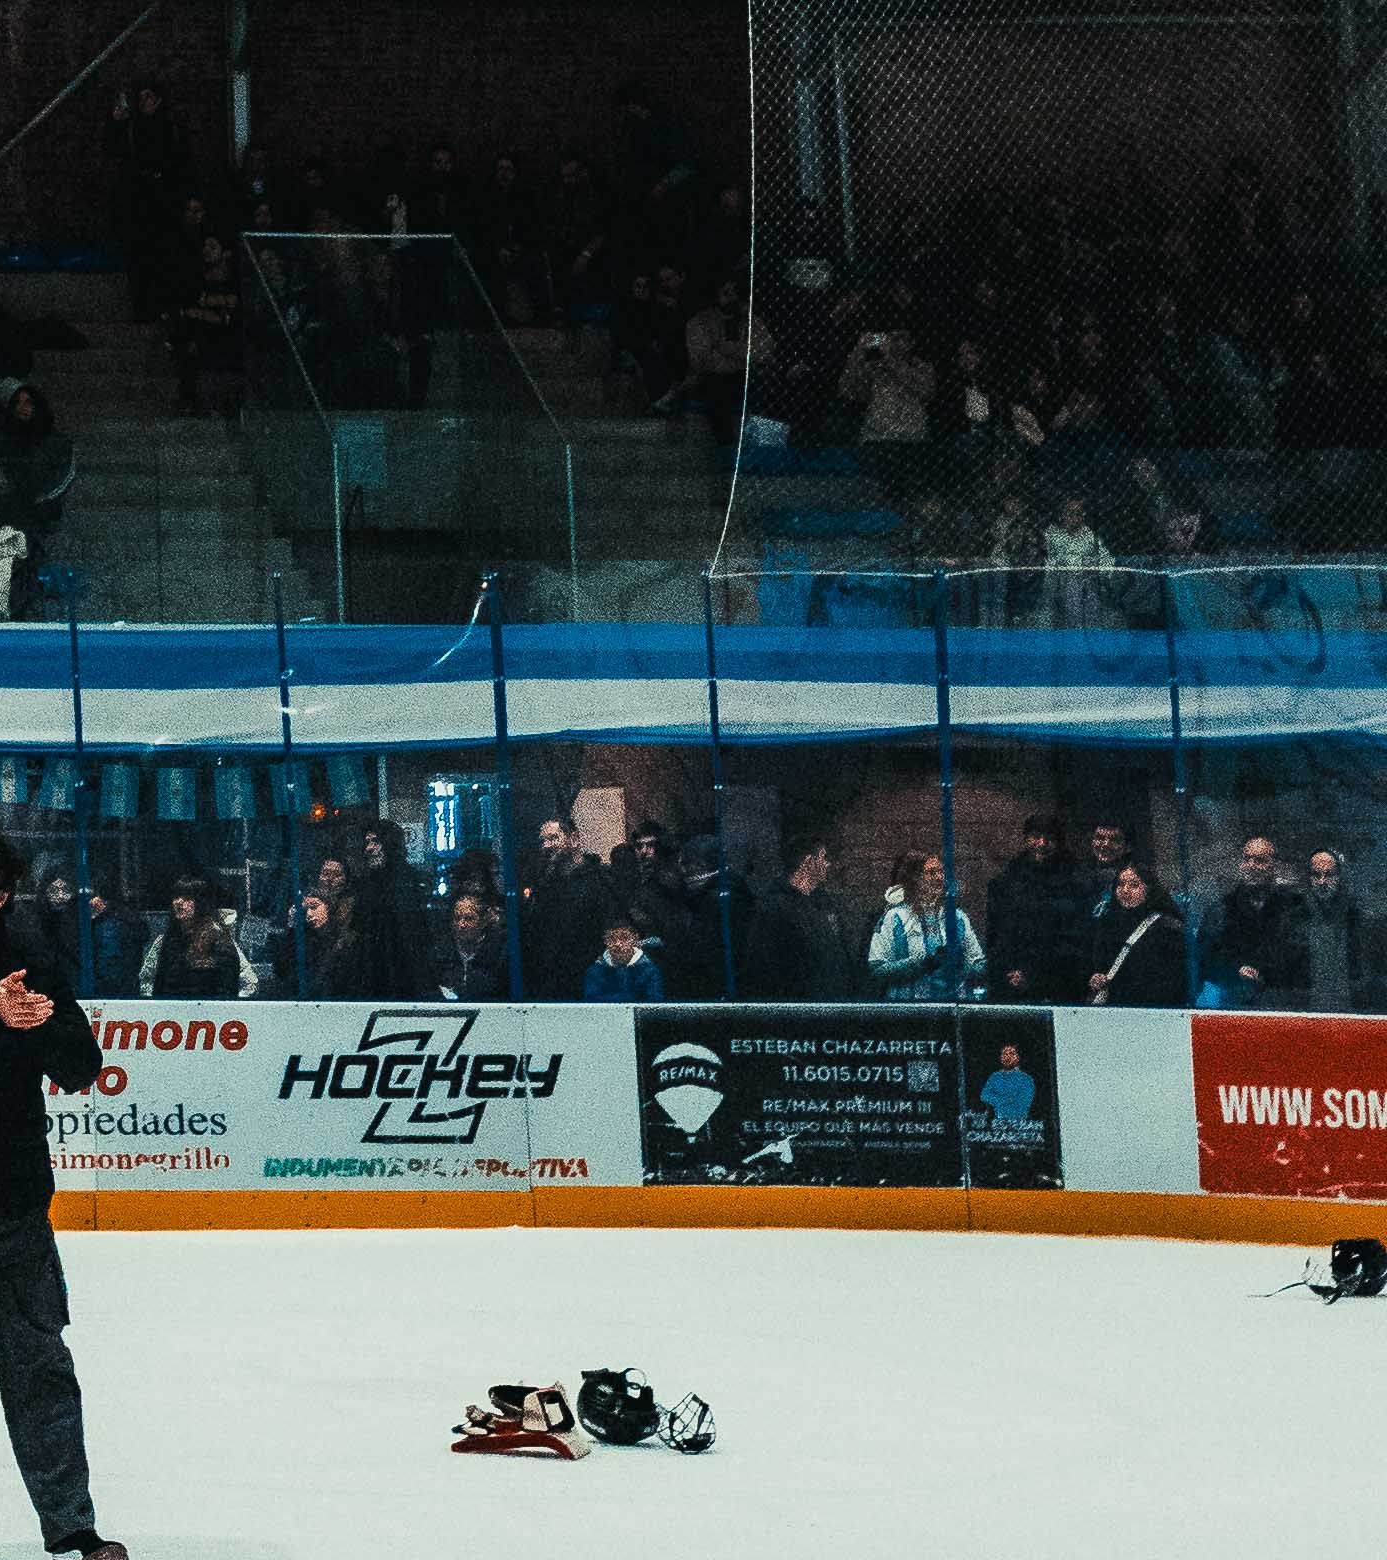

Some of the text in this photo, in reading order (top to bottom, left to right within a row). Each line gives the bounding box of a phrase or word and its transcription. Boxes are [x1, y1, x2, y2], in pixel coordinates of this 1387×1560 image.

[730, 1039, 953, 1055] ESTEBAN CHAZARRETA
[278, 1053, 563, 1100] HOCKEY
[659, 1065, 718, 1083] RE/MAX
[782, 1065, 905, 1082] 11.6015.0715
[762, 1099, 829, 1113] RE/MAX
[835, 1097, 913, 1114] PREMIUM
